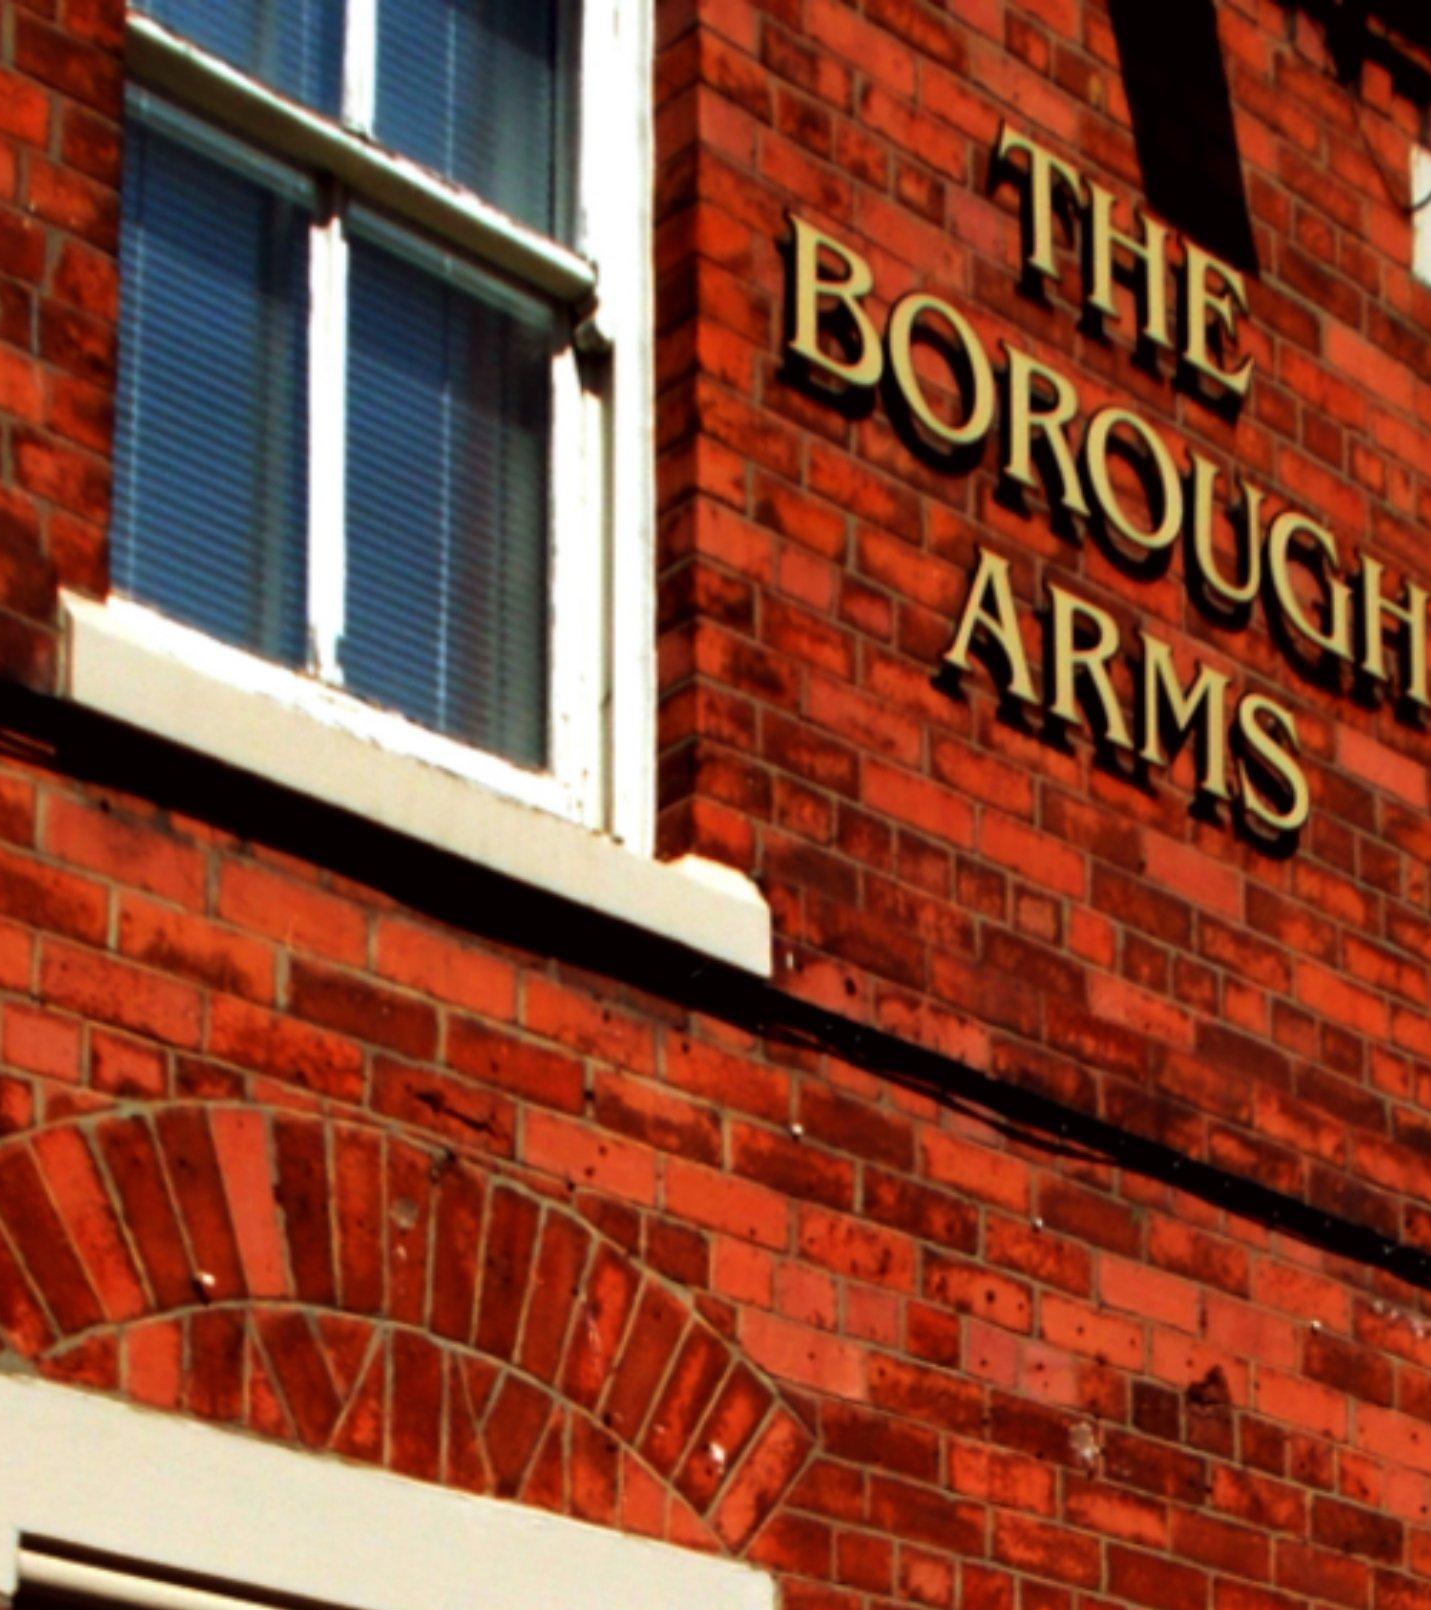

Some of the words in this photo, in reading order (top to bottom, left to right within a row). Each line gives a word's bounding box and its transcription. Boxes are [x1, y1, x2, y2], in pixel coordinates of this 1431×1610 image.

[998, 125, 1253, 394] THE
[790, 217, 1431, 708] BOROUGH
[944, 548, 1310, 830] ARMS
